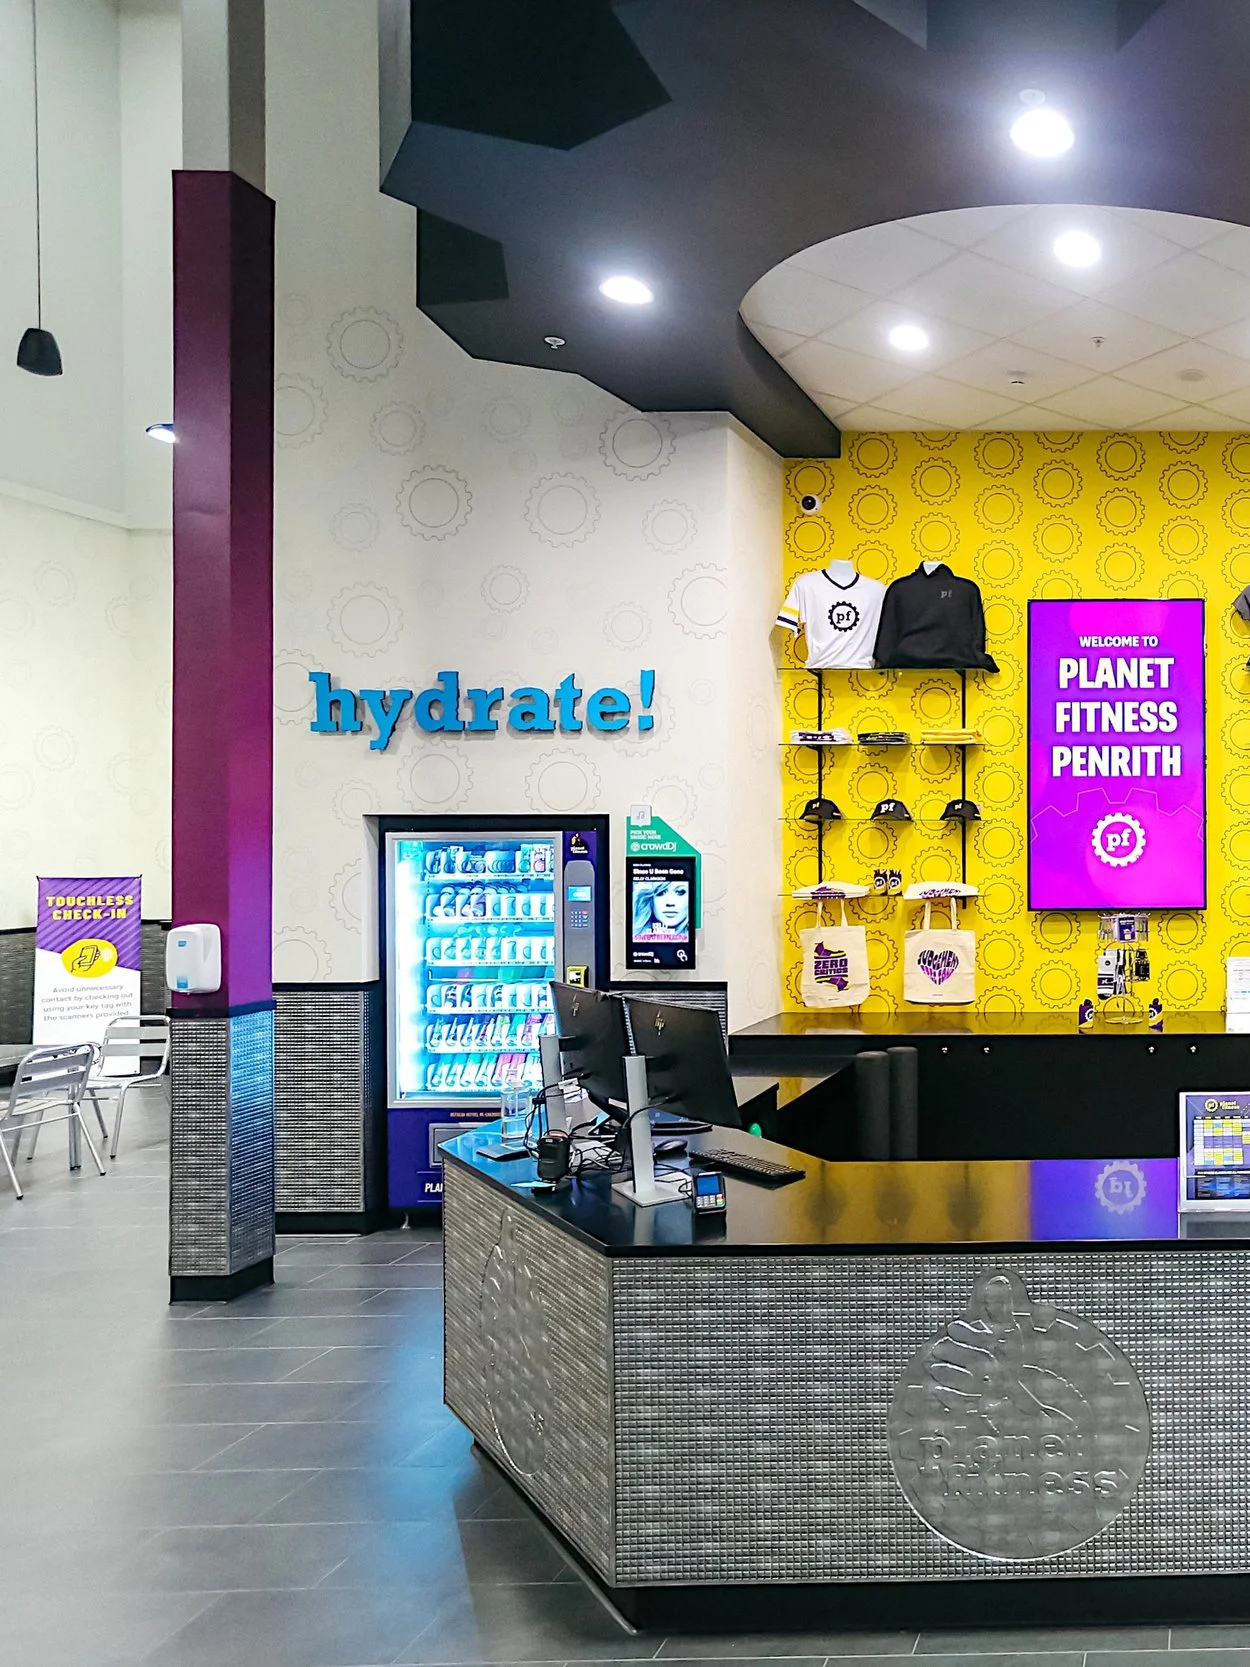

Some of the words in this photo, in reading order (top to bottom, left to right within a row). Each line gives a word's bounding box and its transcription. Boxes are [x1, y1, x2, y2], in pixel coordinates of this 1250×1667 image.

[836, 610, 853, 625] pf
[1078, 635, 1140, 648] WELCOME
[1141, 635, 1159, 648] TO
[1058, 657, 1175, 689] PLANET
[308, 669, 656, 751] hydrate!
[1055, 701, 1179, 733] FITNESS
[1051, 745, 1182, 777] PENRITH
[811, 801, 820, 809] pf
[879, 802, 896, 813] pf
[954, 802, 963, 810] pf
[1105, 828, 1133, 852] pf
[46, 894, 135, 907] TOUCHLESS
[52, 908, 128, 921] CHECK-IN
[813, 958, 848, 969] ZERO
[814, 967, 848, 976] CRITICS
[76, 984, 124, 993] unnecessary
[41, 995, 72, 1003] contact
[73, 995, 84, 1003] by
[84, 993, 120, 1002] checking
[43, 1005, 65, 1013] using
[66, 1004, 85, 1012] your
[85, 1002, 99, 1010] key
[100, 1001, 115, 1010] tag
[115, 1000, 132, 1008] with
[43, 1013, 58, 1021] the
[59, 1011, 94, 1020] scanners
